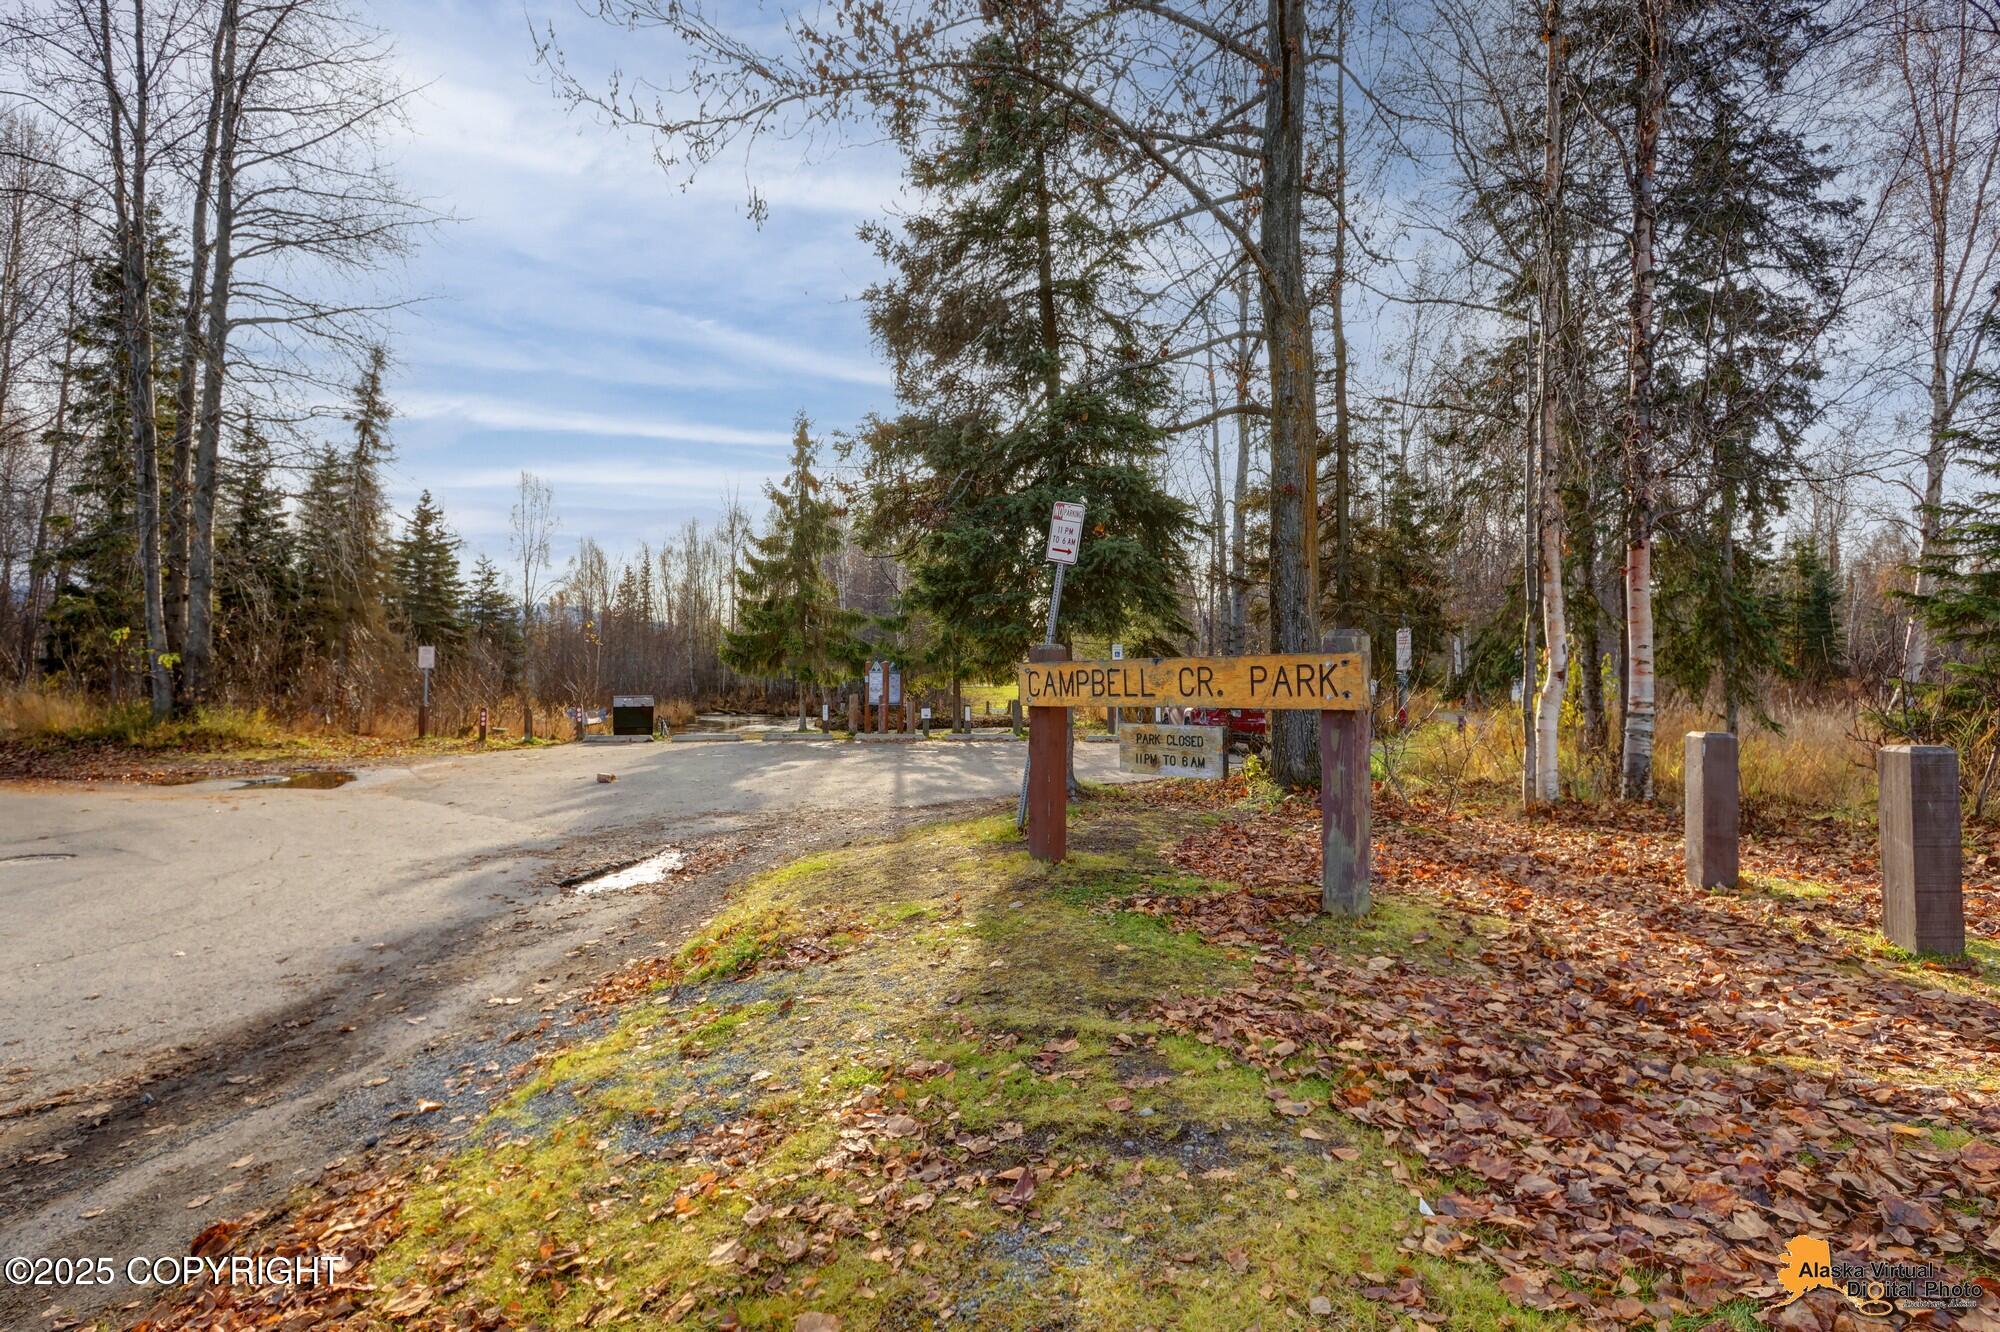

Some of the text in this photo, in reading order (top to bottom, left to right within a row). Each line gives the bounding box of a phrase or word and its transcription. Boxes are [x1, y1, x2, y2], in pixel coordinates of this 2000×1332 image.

[1058, 526, 1074, 535] 11 PM
[1053, 535, 1060, 543] TO
[1028, 663, 1339, 698] CAMPBELL CR. PARK
[1136, 733, 1204, 748] PARK CLOSED
[1163, 755, 1176, 766] TO
